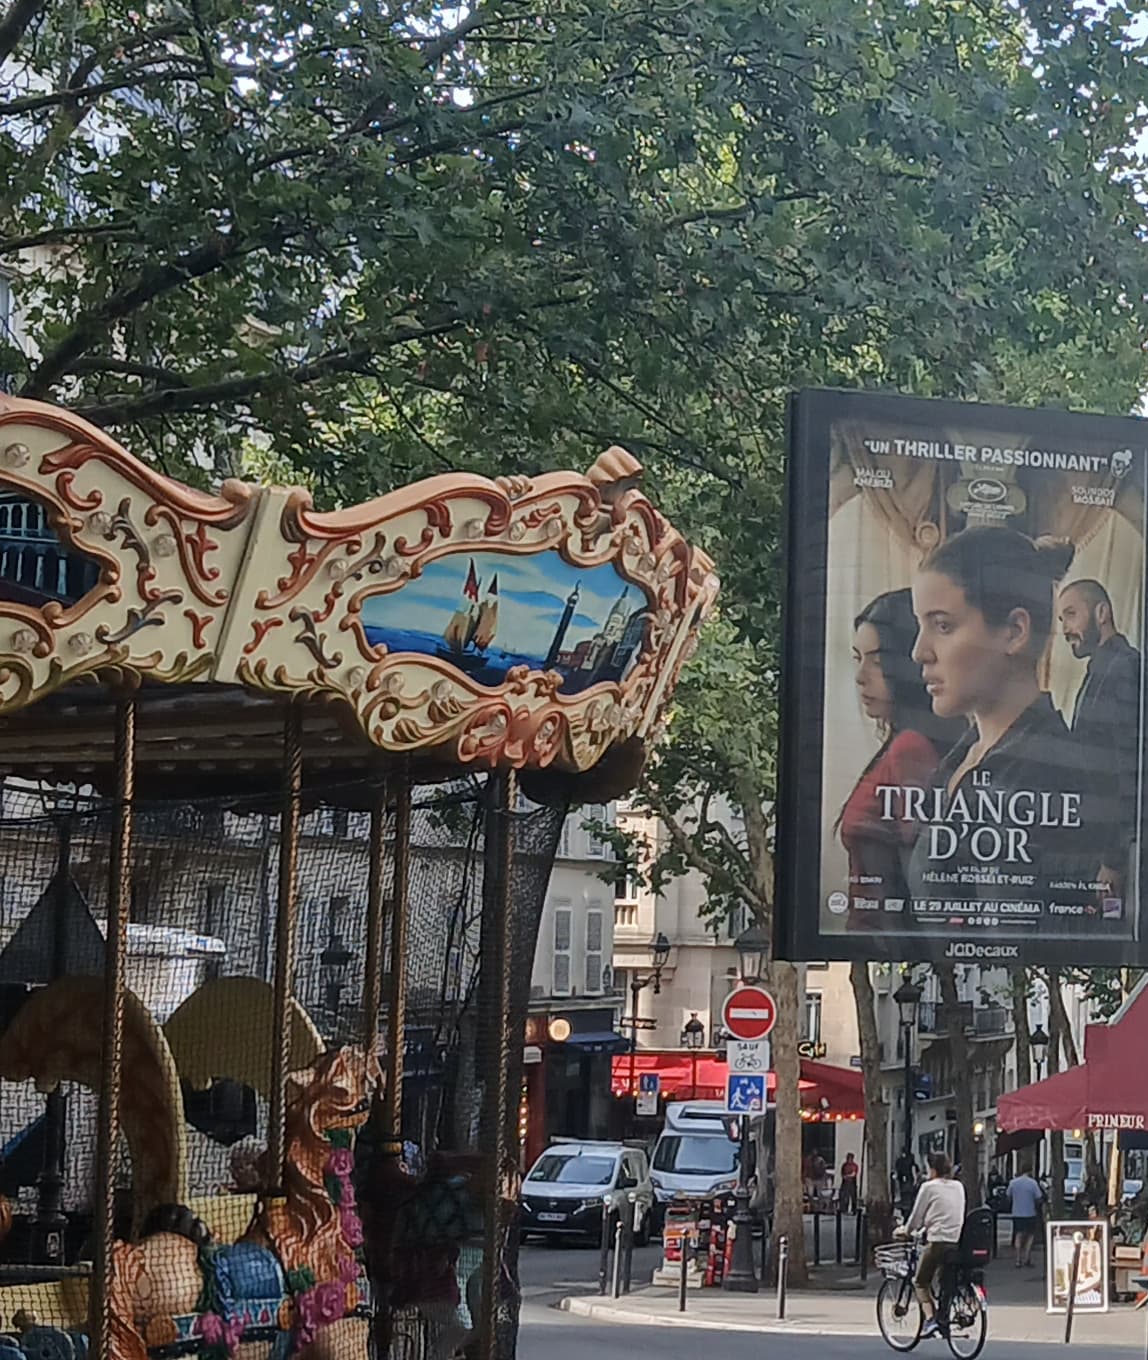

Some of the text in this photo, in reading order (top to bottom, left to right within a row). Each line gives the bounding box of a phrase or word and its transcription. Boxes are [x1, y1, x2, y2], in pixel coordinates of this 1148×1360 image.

[894, 440, 977, 461] THRILLER
[981, 448, 1108, 472] PASSIONNANT"
[973, 771, 990, 786] LE
[876, 786, 1081, 827] TRIANGLE
[928, 824, 1032, 863] D'OR
[983, 902, 998, 912] AU
[945, 943, 1018, 957] JCDecaux
[737, 1042, 759, 1051] SAUF
